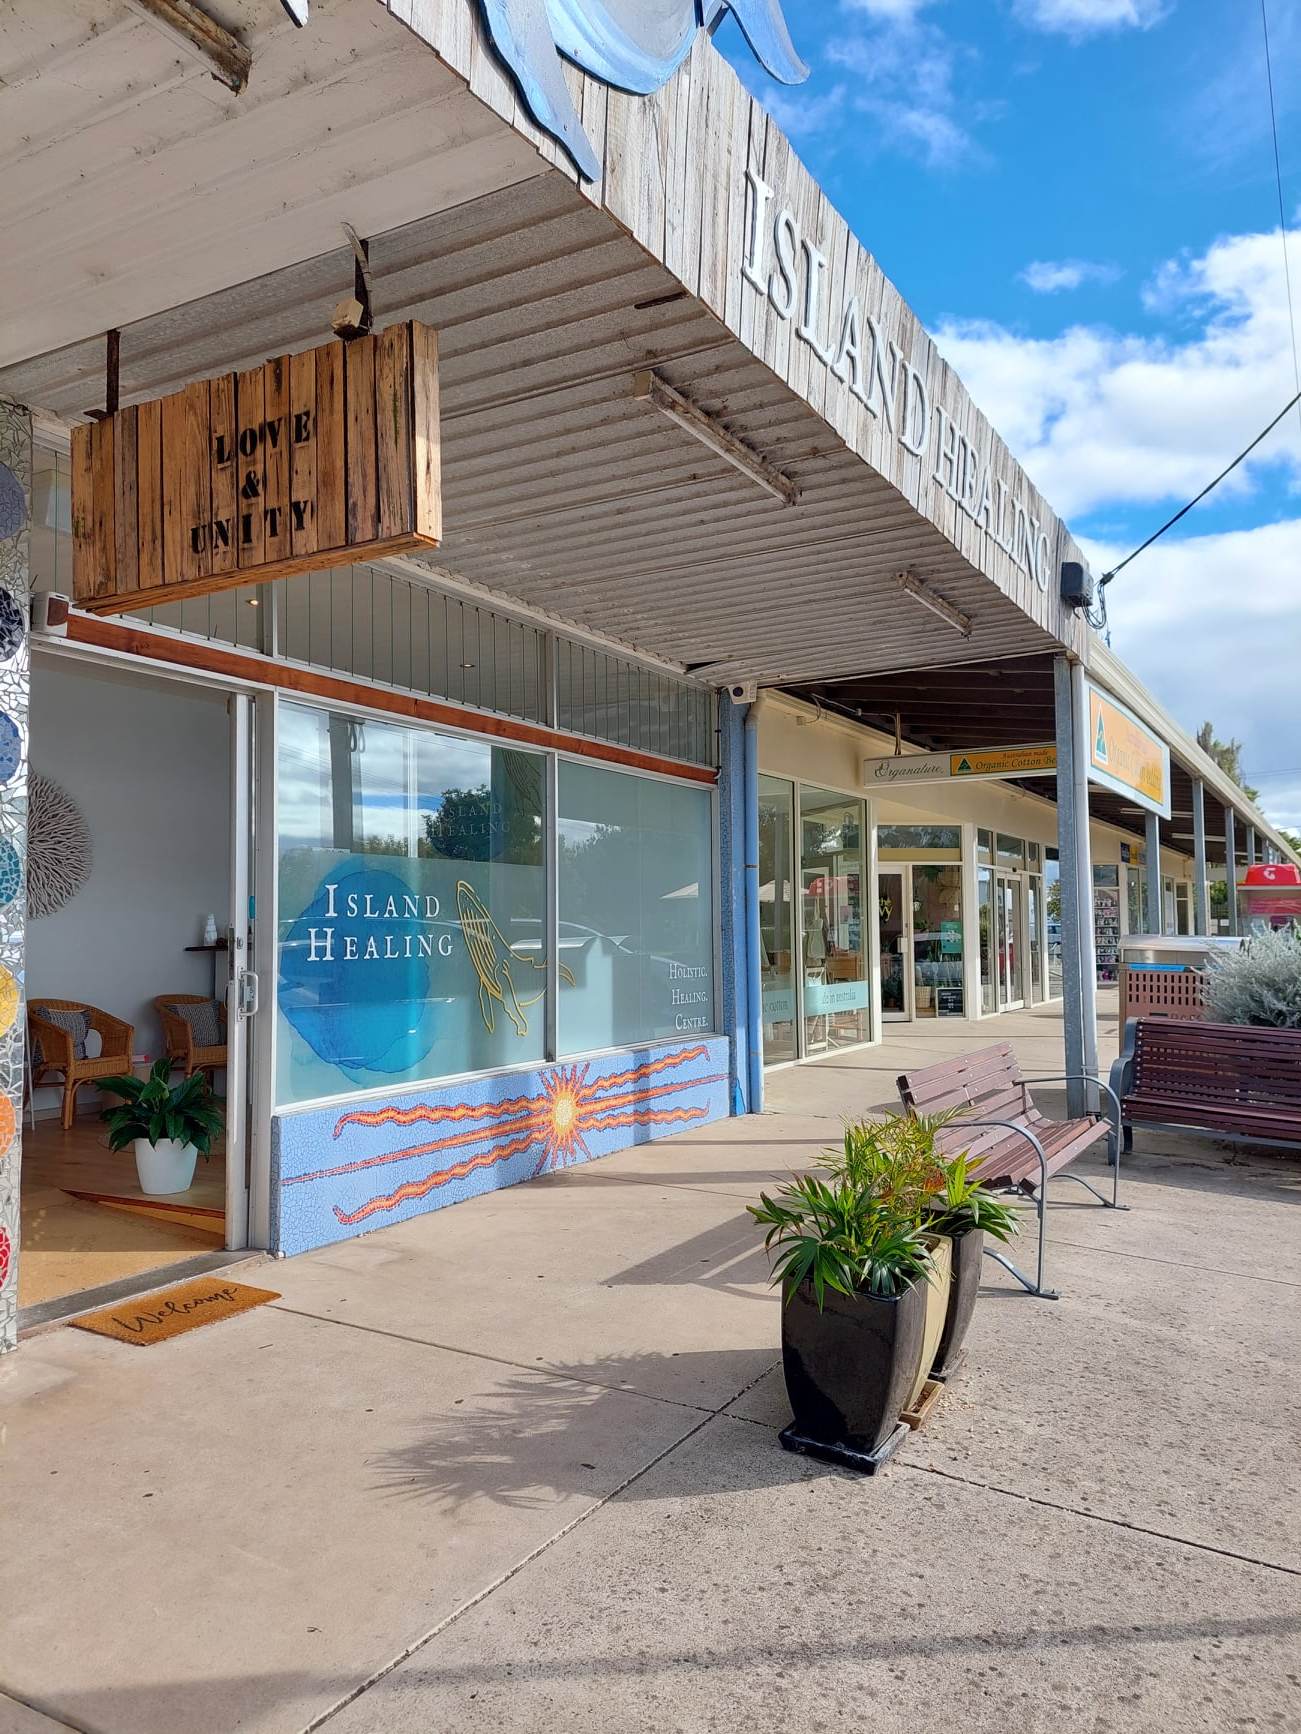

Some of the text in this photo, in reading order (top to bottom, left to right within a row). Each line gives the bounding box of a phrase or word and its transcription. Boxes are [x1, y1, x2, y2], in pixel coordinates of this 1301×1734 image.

[742, 167, 1051, 593] ISLAND HEALING
[214, 409, 312, 466] LOVE
[242, 470, 261, 499] &
[190, 500, 312, 555] UNITY
[324, 884, 440, 918] ISLAND
[306, 927, 454, 961] HEALING
[112, 1287, 238, 1333] Welcome
